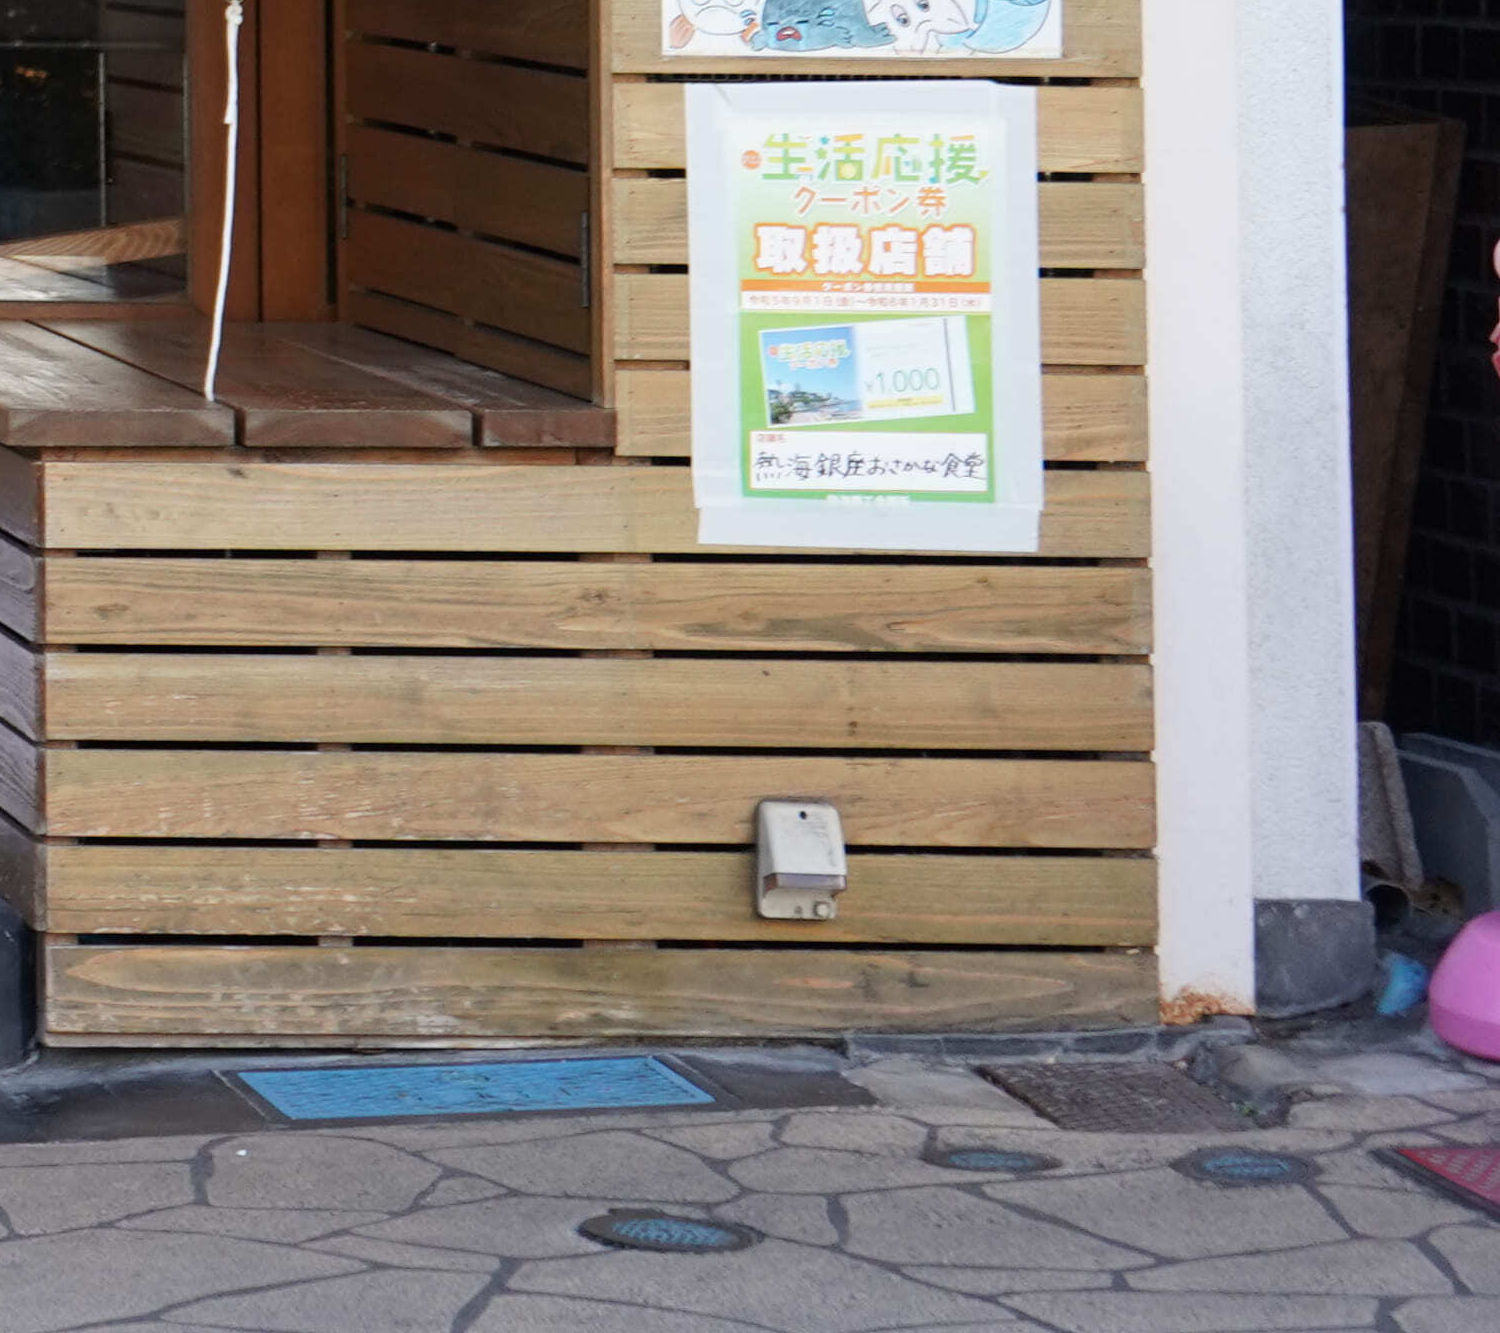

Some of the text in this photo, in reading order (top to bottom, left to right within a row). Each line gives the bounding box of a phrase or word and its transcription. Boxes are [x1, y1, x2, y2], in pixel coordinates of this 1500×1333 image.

[762, 133, 988, 184] 生活応援
[792, 186, 947, 217] クーポン券
[754, 222, 978, 279] 取扱店舗
[753, 450, 989, 483] 熱海銀座おさかな食堂
